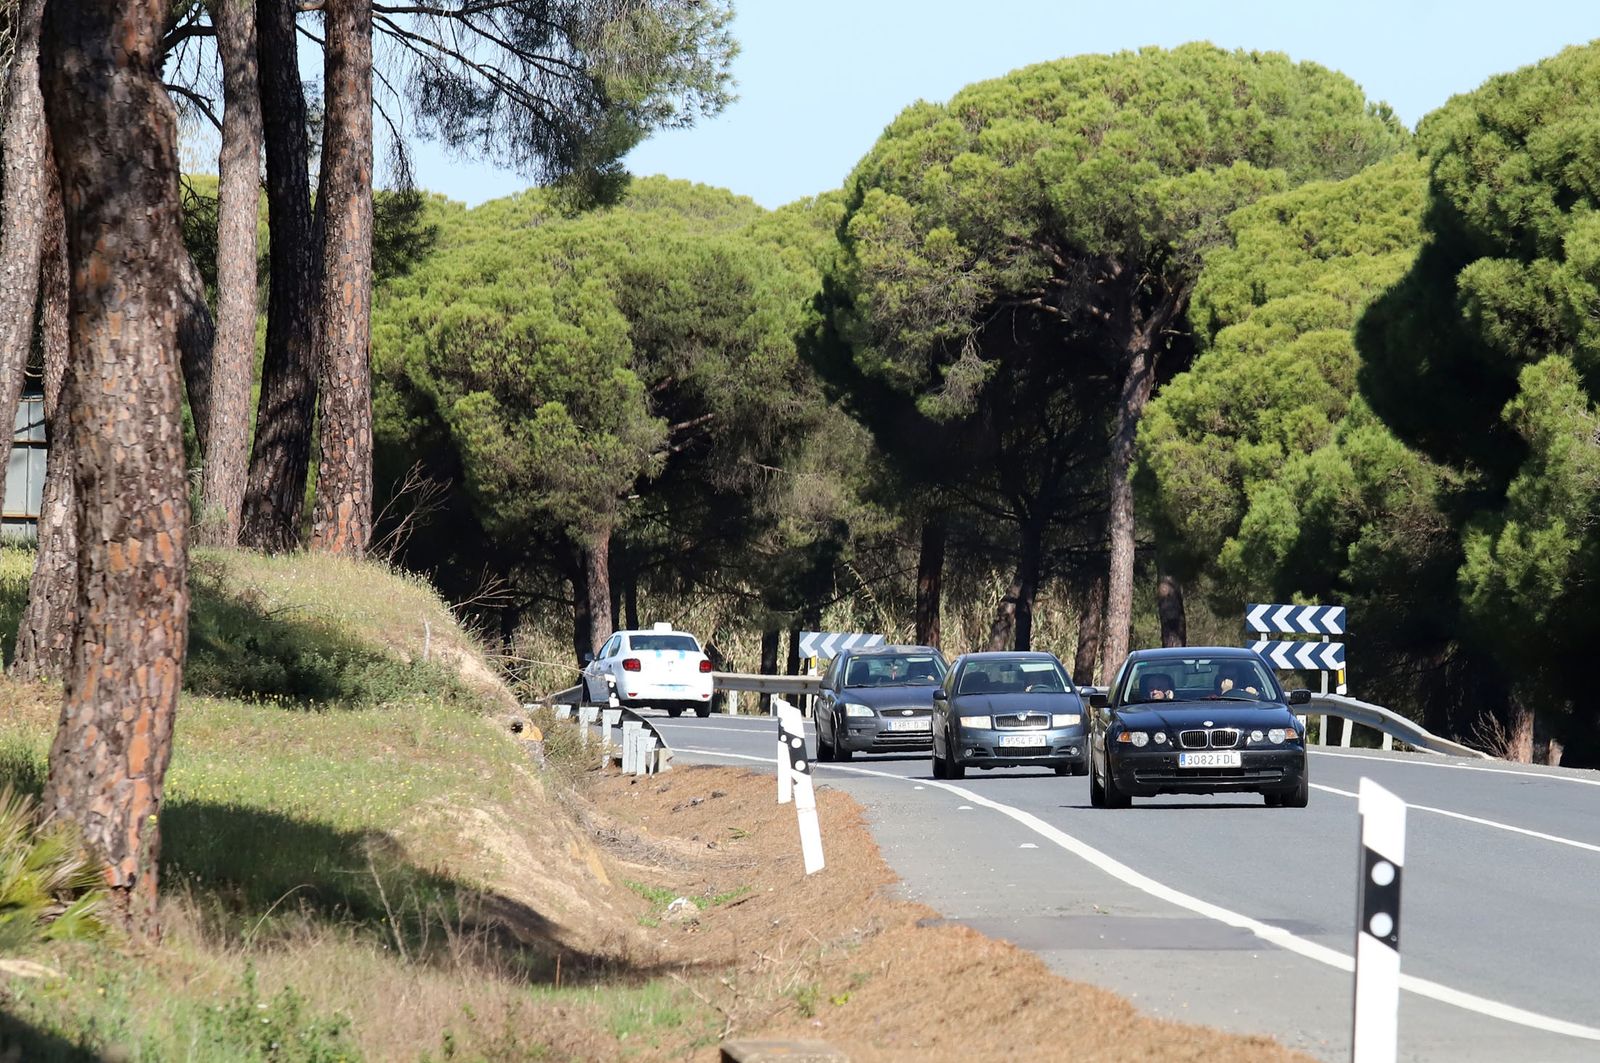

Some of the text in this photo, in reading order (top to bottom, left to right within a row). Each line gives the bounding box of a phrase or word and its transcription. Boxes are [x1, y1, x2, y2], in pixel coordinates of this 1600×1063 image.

[1005, 736, 1044, 745] 9554 FJX
[1187, 754, 1236, 765] 3082 FDL
